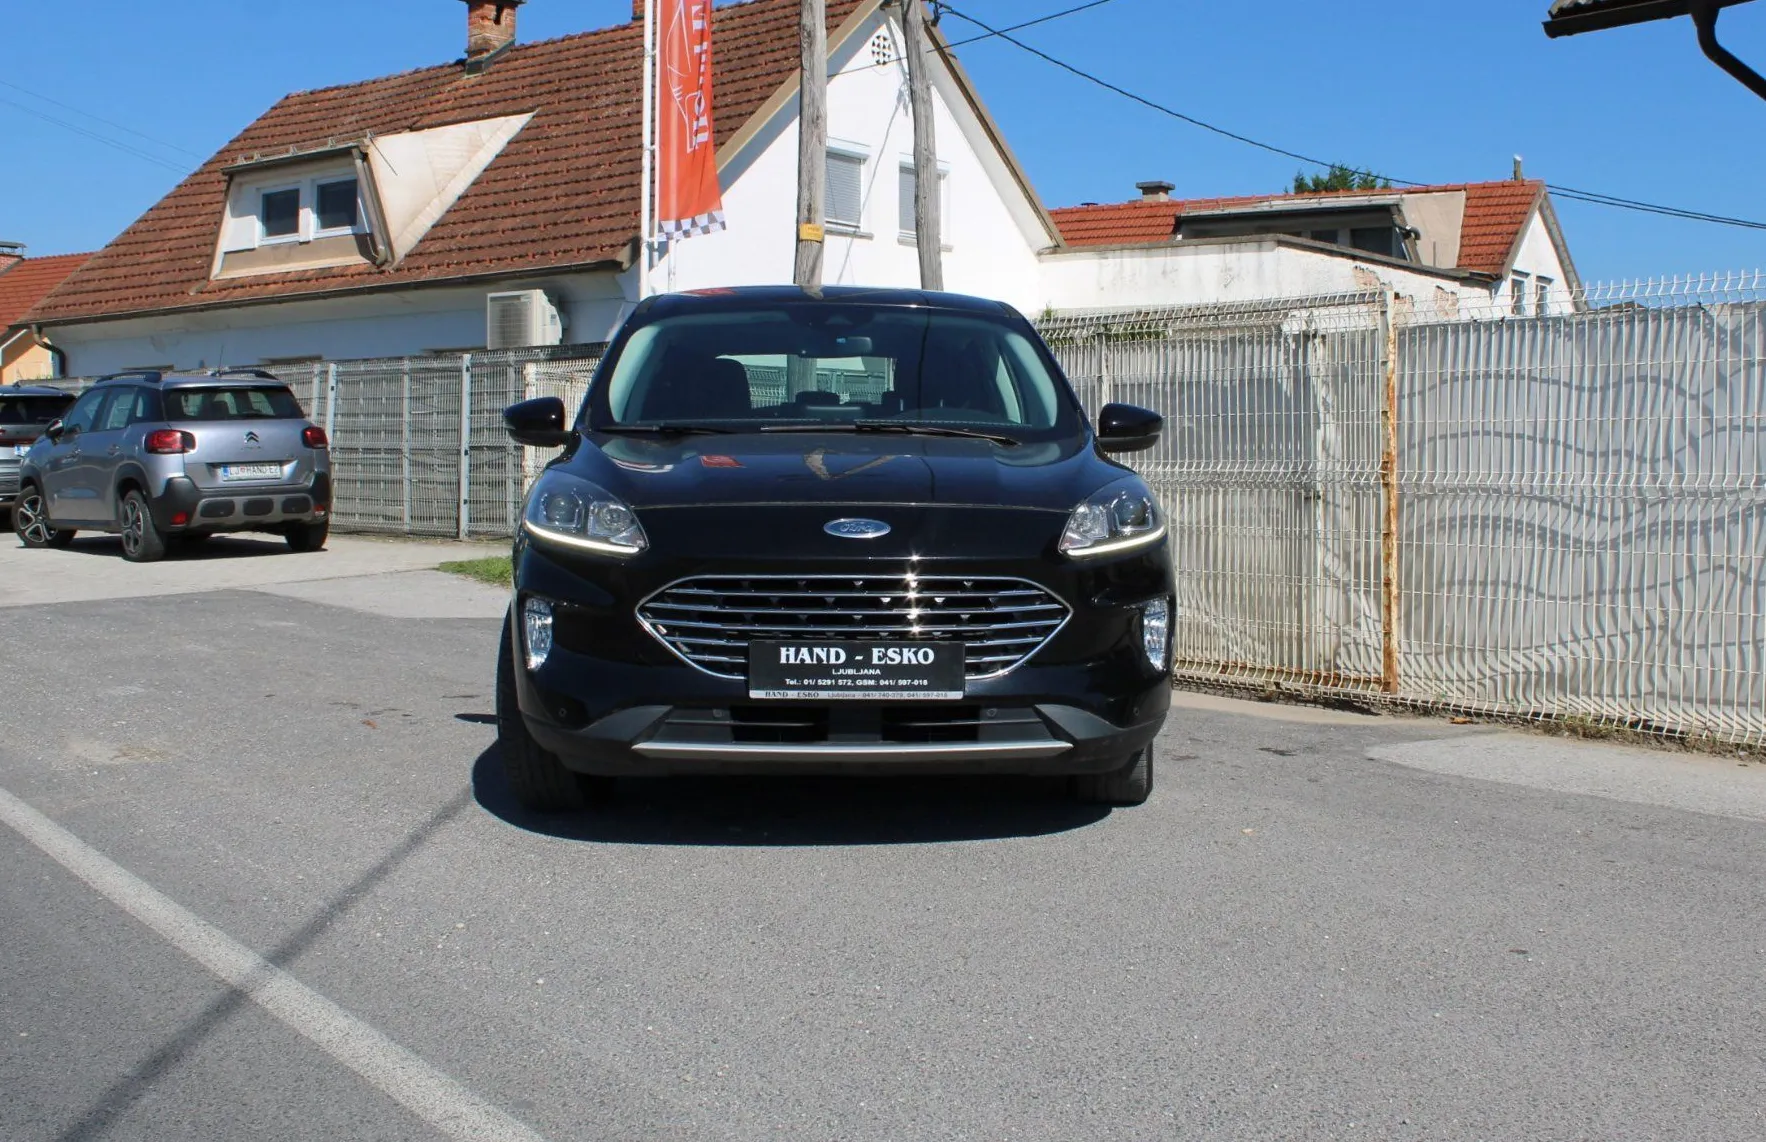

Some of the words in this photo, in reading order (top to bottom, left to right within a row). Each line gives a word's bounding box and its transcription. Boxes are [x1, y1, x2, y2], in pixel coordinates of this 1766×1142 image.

[840, 521, 876, 534] Ford
[780, 647, 846, 664] HAND
[872, 648, 934, 665] ESKO
[837, 679, 854, 687] 572,
[827, 692, 855, 700] Ljubljana
